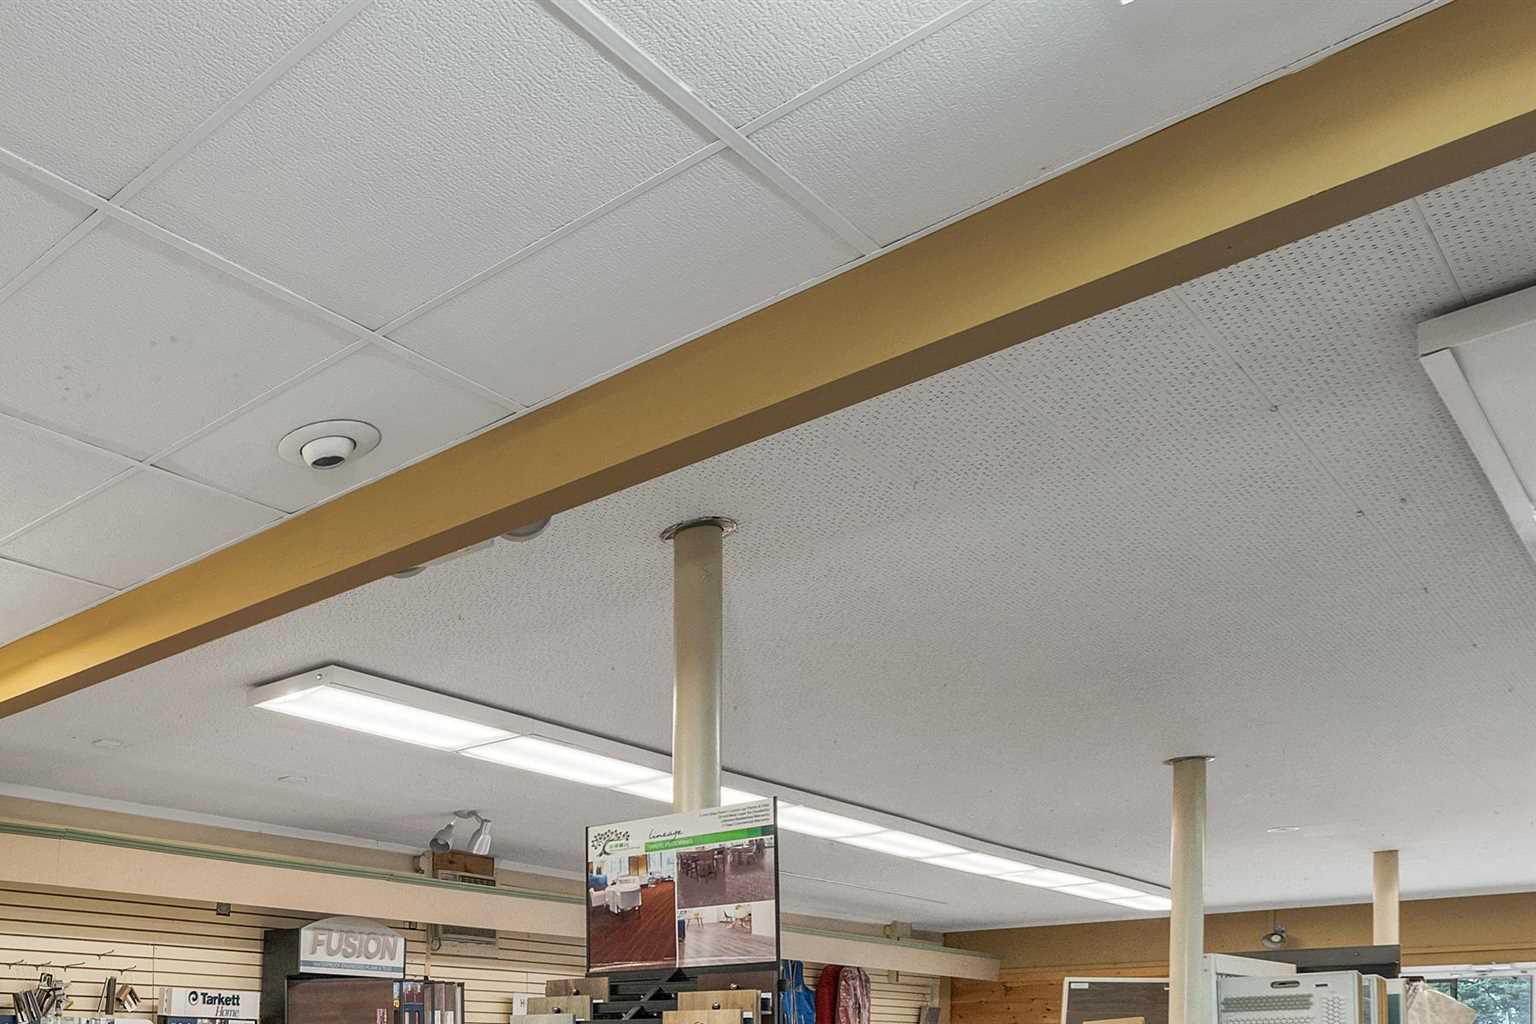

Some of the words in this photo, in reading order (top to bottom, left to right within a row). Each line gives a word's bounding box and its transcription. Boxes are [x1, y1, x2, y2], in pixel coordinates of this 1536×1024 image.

[309, 927, 399, 962] FUSION
[200, 992, 241, 1006] Tarkett
[215, 1006, 240, 1017] Home
